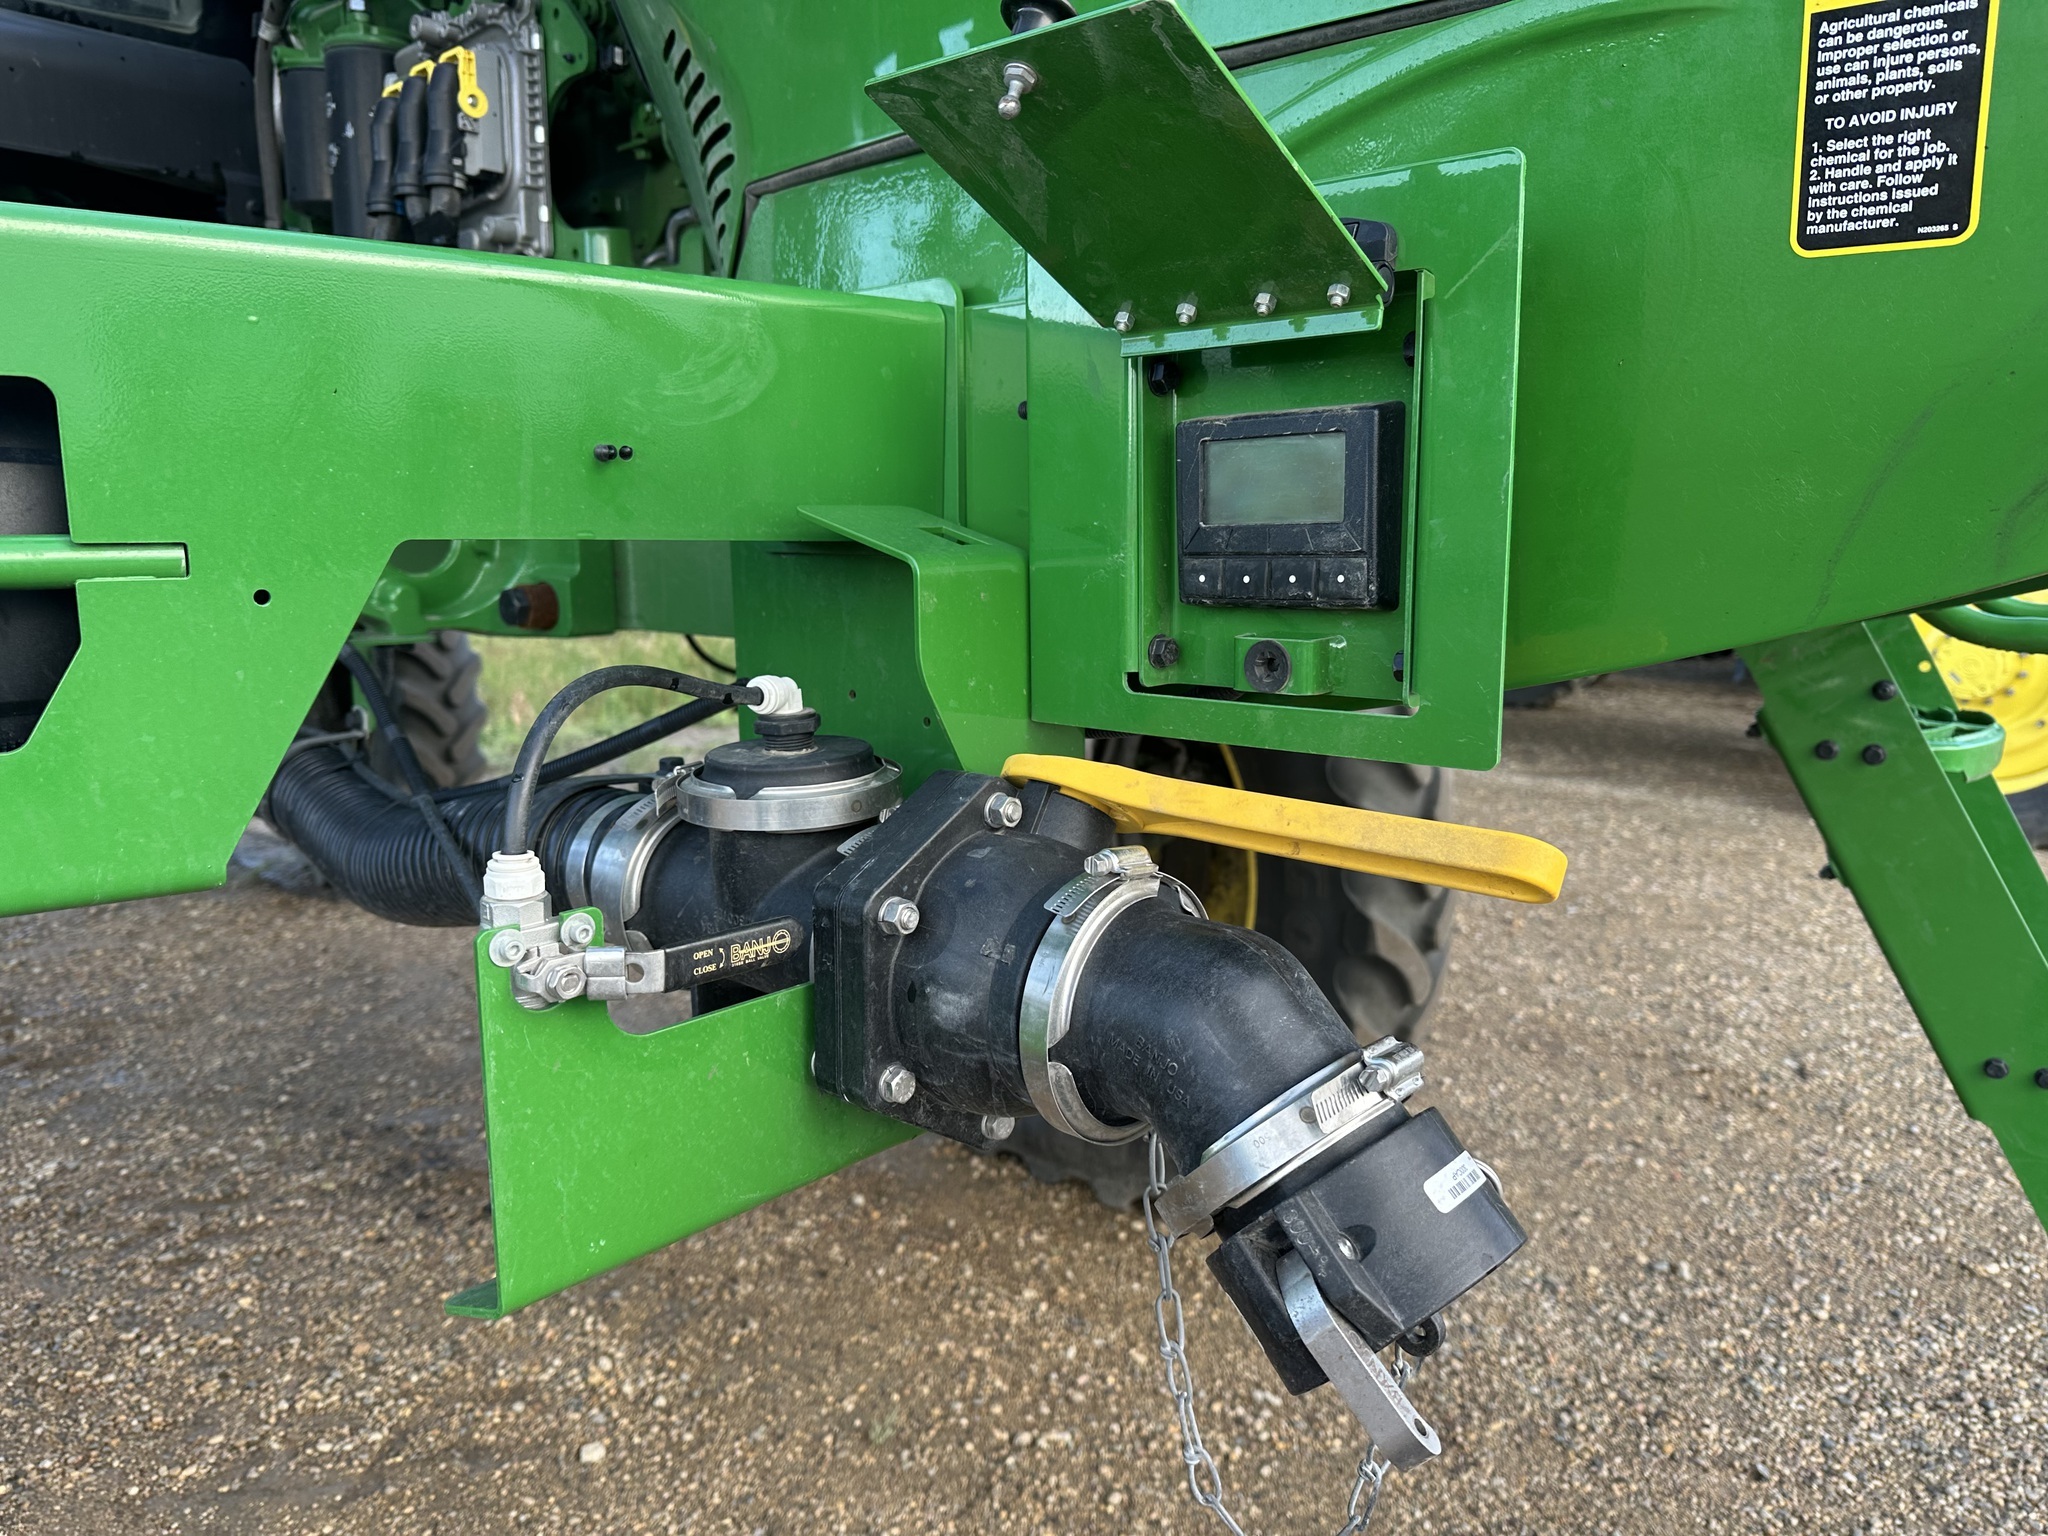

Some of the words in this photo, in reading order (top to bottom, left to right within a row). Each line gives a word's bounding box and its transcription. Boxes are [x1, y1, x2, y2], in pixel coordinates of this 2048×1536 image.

[1819, 9, 1900, 35] Agricultural
[1904, 0, 1978, 20] chemicals
[1818, 35, 1842, 48] can
[1846, 30, 1863, 44] be
[1867, 18, 1947, 40] dangerous.
[1883, 32, 1948, 52] selection
[1952, 29, 1969, 41] or
[1816, 64, 1841, 77] use
[1844, 58, 1869, 71] can
[1873, 53, 1914, 69] injure
[1917, 43, 1981, 64] persons,
[1815, 73, 1872, 91] animals,
[1875, 65, 1924, 84] plants,
[1927, 59, 1963, 75] soils
[1814, 94, 1829, 105] or
[1832, 88, 1868, 102] other
[1871, 78, 1936, 100] property.
[1825, 117, 1845, 130] TO
[1849, 110, 1896, 127] AVOID
[1900, 101, 1958, 121] INJURY
[1810, 150, 1870, 167] chemical
[1874, 148, 1894, 161] for
[1897, 145, 1920, 157] the
[1923, 140, 1950, 157] job.
[1811, 141, 1823, 153] 1.
[1826, 134, 1868, 151] Select
[1872, 132, 1894, 145] the
[1898, 128, 1932, 143] right
[1809, 169, 1821, 181] 2.
[1824, 163, 1872, 180] Handle
[1875, 160, 1902, 174] and
[1904, 155, 1944, 172] apply
[1948, 153, 1958, 166] it
[1808, 181, 1836, 195] with
[1840, 180, 1873, 192] care.
[1877, 173, 1924, 188] Follow
[1808, 190, 1888, 208] instructions
[1892, 183, 1939, 200] issued
[1807, 210, 1823, 223] by
[1826, 207, 1848, 220] the
[1851, 200, 1913, 218] chemical
[1806, 217, 1899, 235] manufacturer.
[693, 948, 714, 960] OPEN
[730, 929, 791, 963] BANJO
[693, 963, 717, 976] CLOSE
[1134, 1035, 1178, 1076] BANJO
[1108, 1032, 1141, 1066] MADE
[1146, 1063, 1160, 1082] IN
[1166, 1082, 1190, 1108] USA
